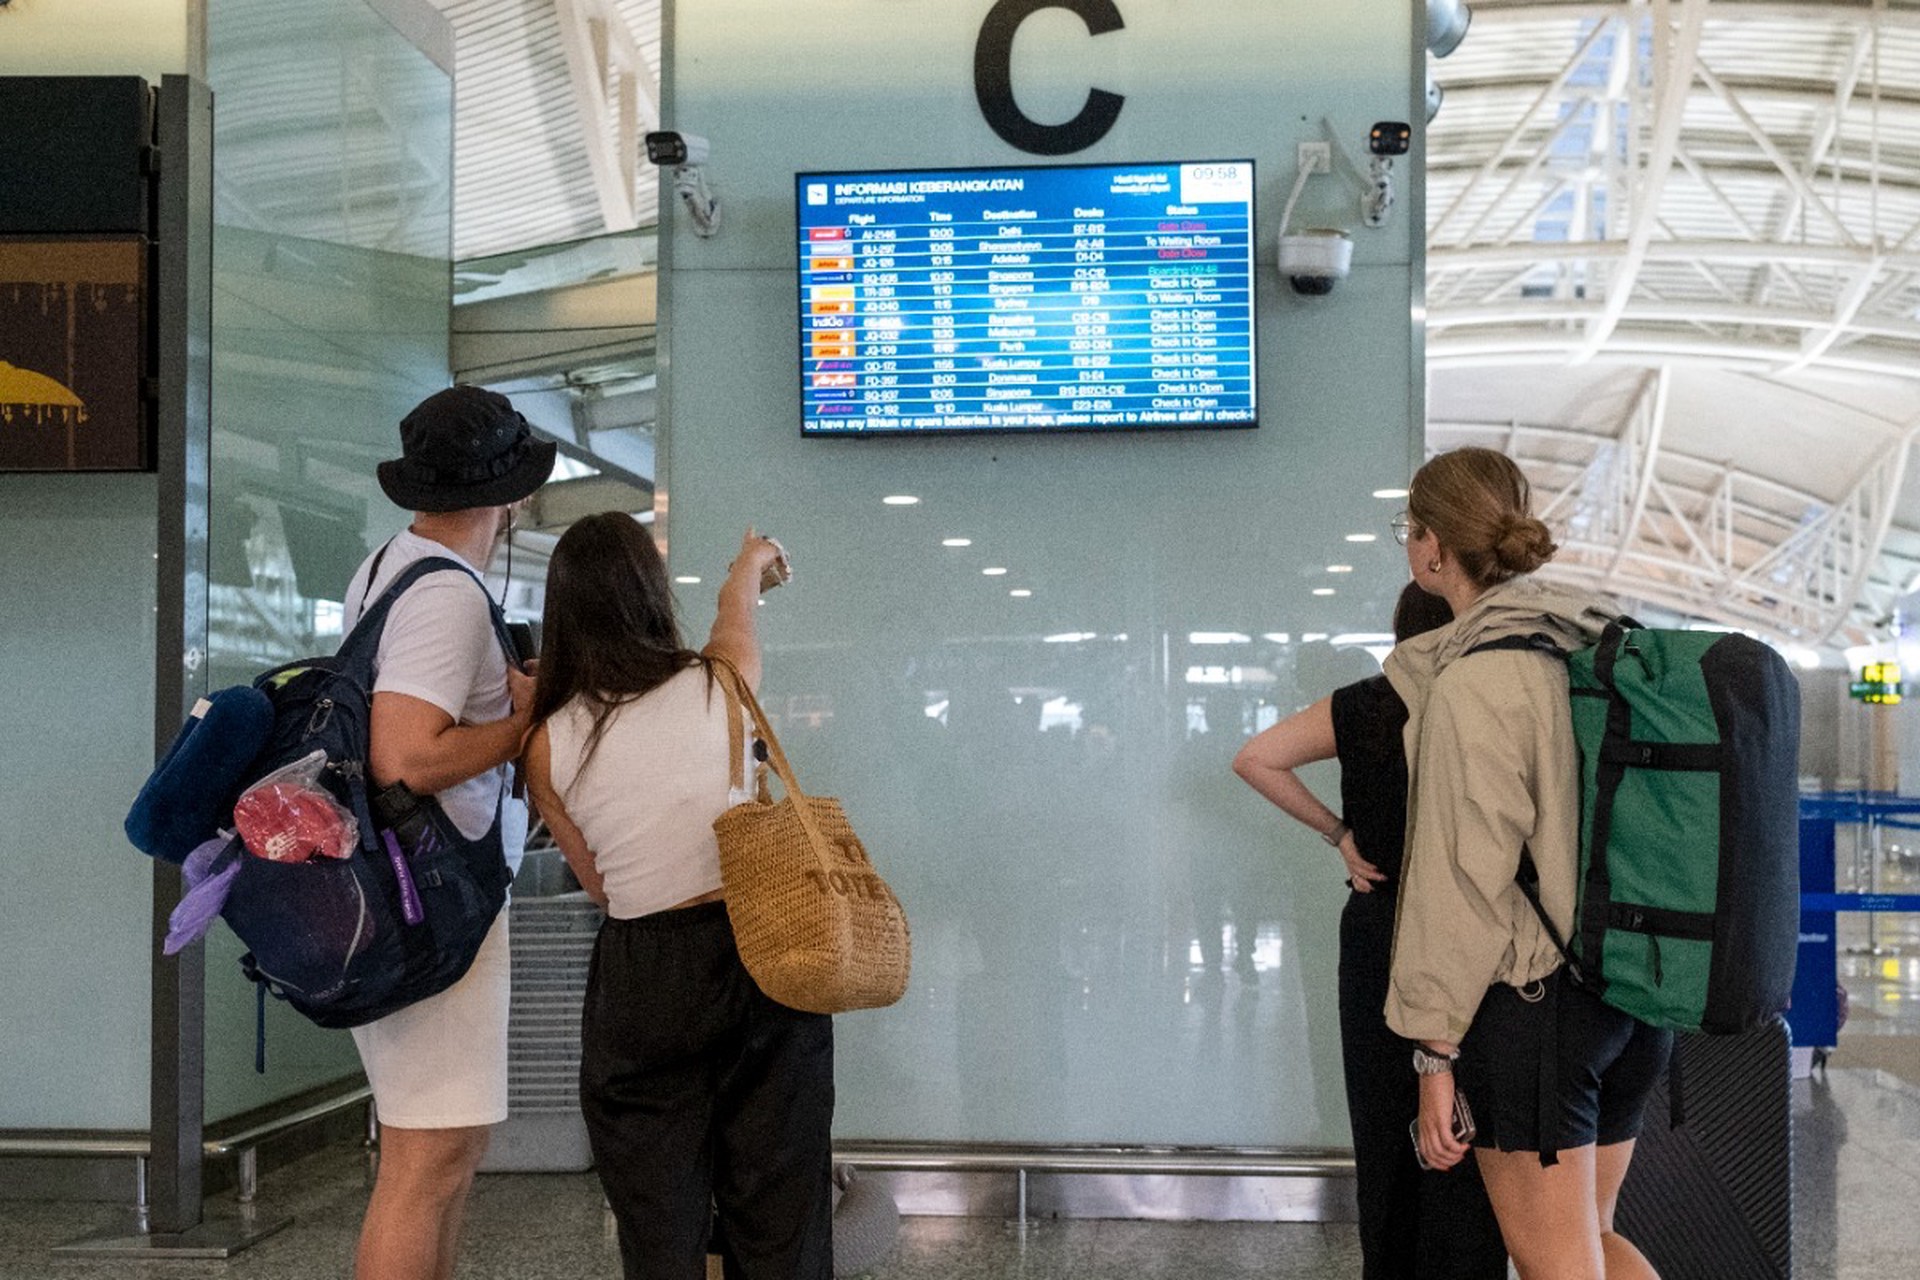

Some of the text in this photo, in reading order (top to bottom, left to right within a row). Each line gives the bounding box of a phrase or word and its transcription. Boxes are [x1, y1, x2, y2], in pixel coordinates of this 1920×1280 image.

[974, 0, 1125, 156] C
[835, 179, 1023, 196] INFORMASI KEBERANGKATAN
[835, 197, 875, 205] DEPARTURE
[849, 214, 875, 226] Flight
[930, 212, 952, 222] Time
[930, 228, 954, 238] 10:00
[1146, 236, 1221, 248] To Waiting Room
[1150, 278, 1179, 288] Check
[1191, 278, 1216, 290] Open
[1146, 292, 1221, 304] To Waiting Room
[1151, 310, 1180, 320] Check
[1192, 308, 1216, 320] Open
[1151, 322, 1180, 332] Check
[1192, 321, 1217, 333] Open
[1151, 337, 1180, 347] Check
[1192, 336, 1217, 348] Open
[1152, 354, 1180, 364] Check
[1192, 353, 1217, 364] Open
[1152, 368, 1180, 379] Check
[1192, 368, 1218, 378] Open
[1158, 384, 1187, 394] Check
[1200, 382, 1224, 394] Open
[1152, 398, 1181, 408] Check
[1193, 397, 1218, 409] Open
[820, 419, 844, 429] have
[846, 420, 864, 430] any
[867, 418, 899, 428] lithium
[901, 418, 912, 428] or
[914, 417, 942, 428] spare
[944, 416, 989, 426] batteries
[992, 415, 1001, 426] in
[1003, 416, 1026, 427] your
[1056, 414, 1090, 426] please
[1093, 412, 1123, 424] report
[1126, 412, 1138, 422] to
[1140, 411, 1177, 422] Airlines
[1178, 410, 1202, 422] staff
[1204, 411, 1214, 421] in
